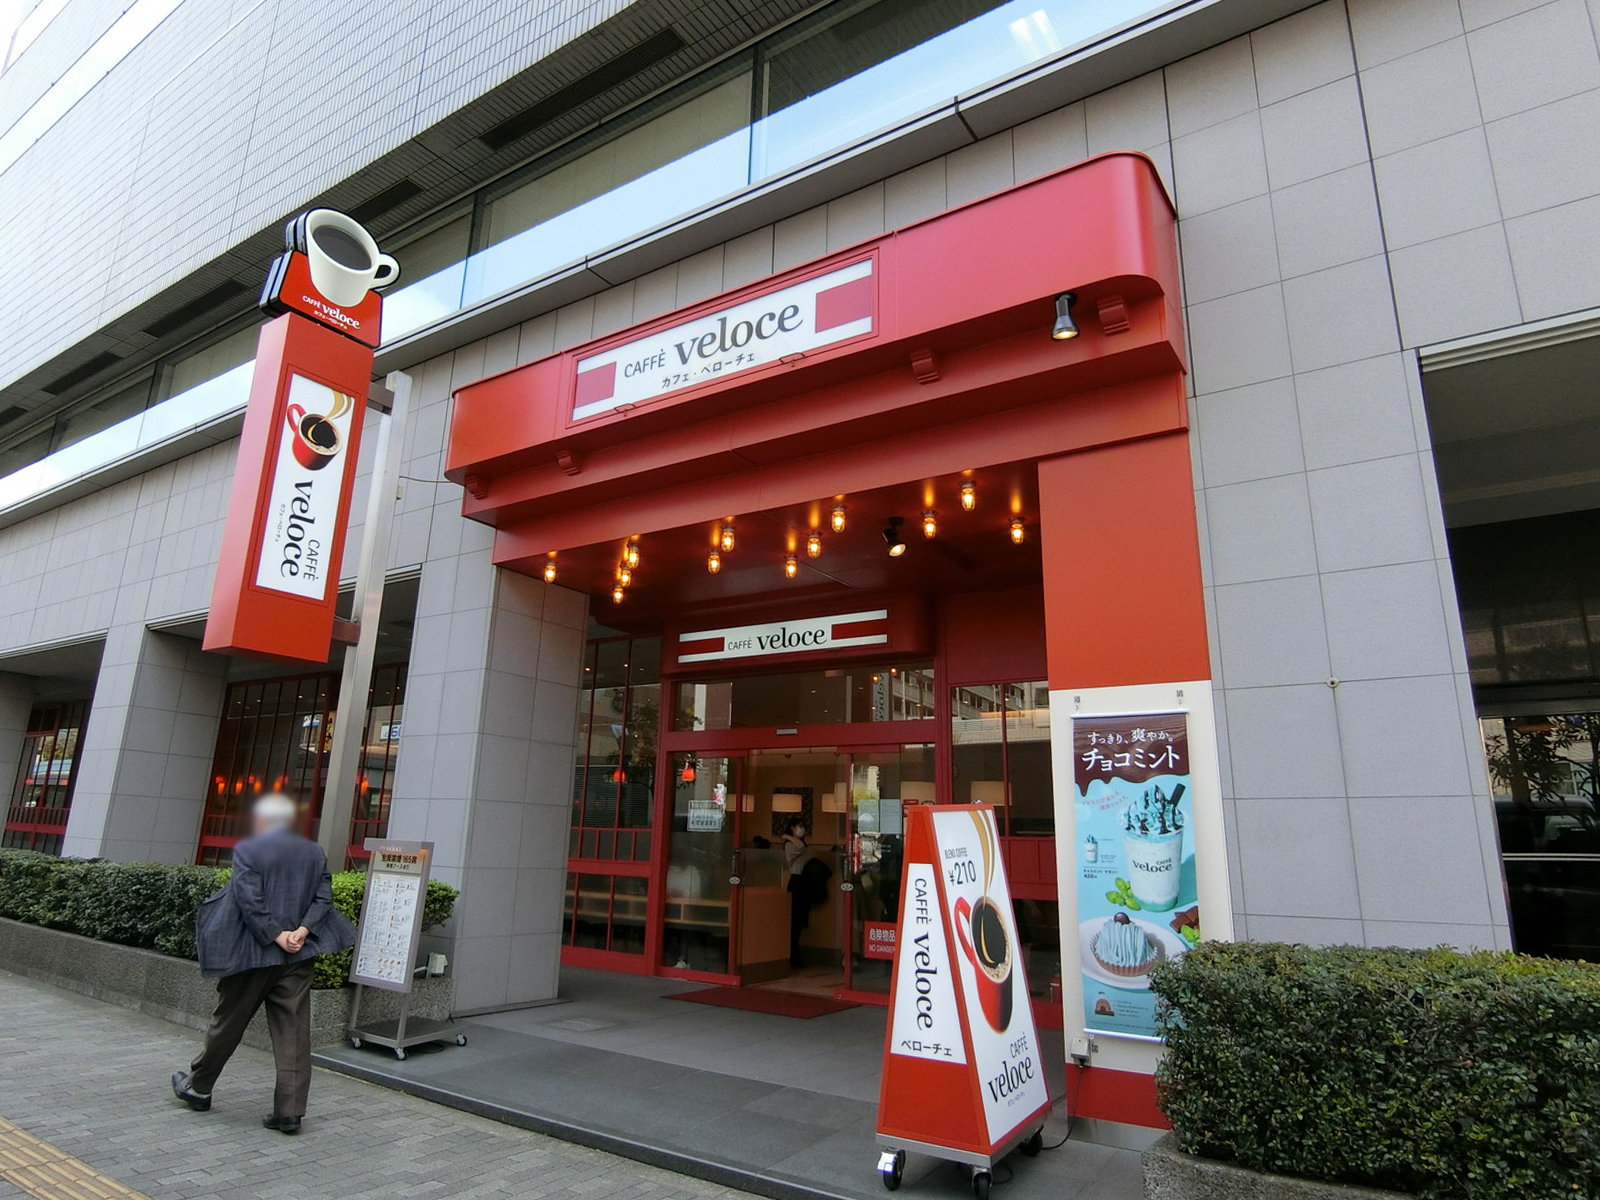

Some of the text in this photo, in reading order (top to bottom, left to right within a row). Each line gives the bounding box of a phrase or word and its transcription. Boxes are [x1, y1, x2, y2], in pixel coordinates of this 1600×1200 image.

[322, 304, 360, 329] veloce
[624, 304, 803, 377] CAFFÈ veloce
[662, 353, 755, 388] カフェ・ベローチェ
[281, 480, 316, 577] veloce
[303, 539, 320, 581] CAFFÈ
[728, 627, 827, 650] CAFFÈ veloce
[1082, 745, 1179, 771] チョコミント
[948, 860, 976, 886] ¥210
[914, 878, 937, 1031] CAFFÈ veloce
[901, 1040, 952, 1056] ベローチェ
[1010, 1031, 1028, 1058] CAFFÈ
[988, 1057, 1034, 1103] veloce
